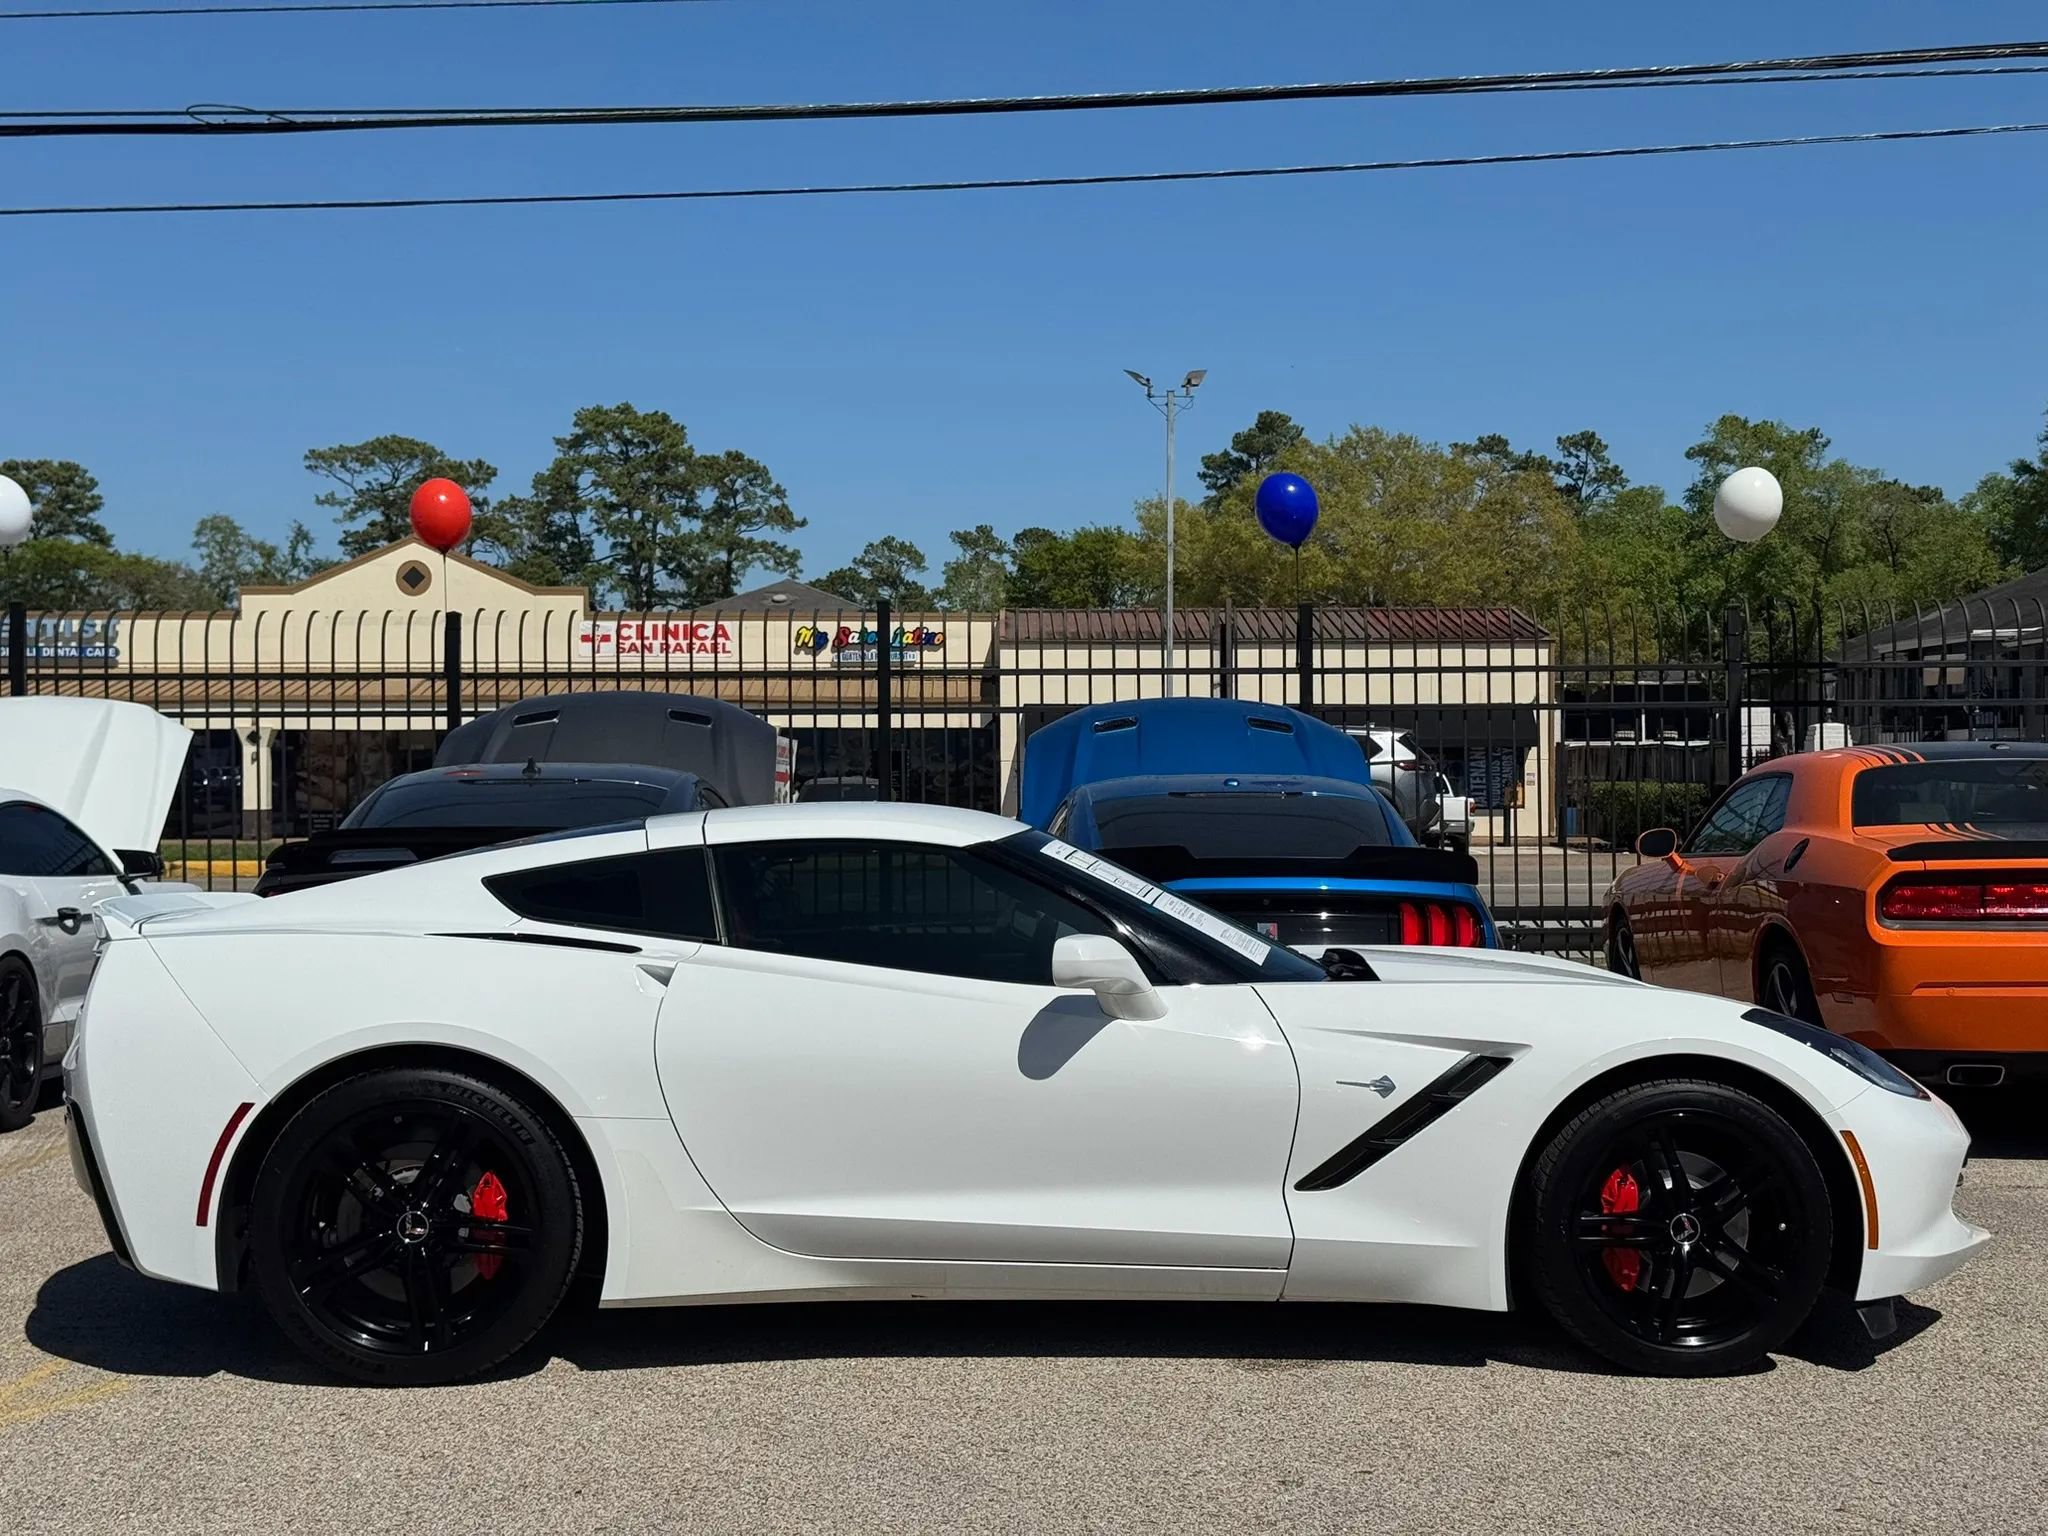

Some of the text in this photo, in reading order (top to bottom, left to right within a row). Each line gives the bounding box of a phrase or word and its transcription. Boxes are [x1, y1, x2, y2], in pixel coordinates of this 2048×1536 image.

[619, 623, 731, 641] CLINICA
[617, 642, 731, 654] SAN RAFAEL
[446, 1084, 533, 1142] MICHELIN
